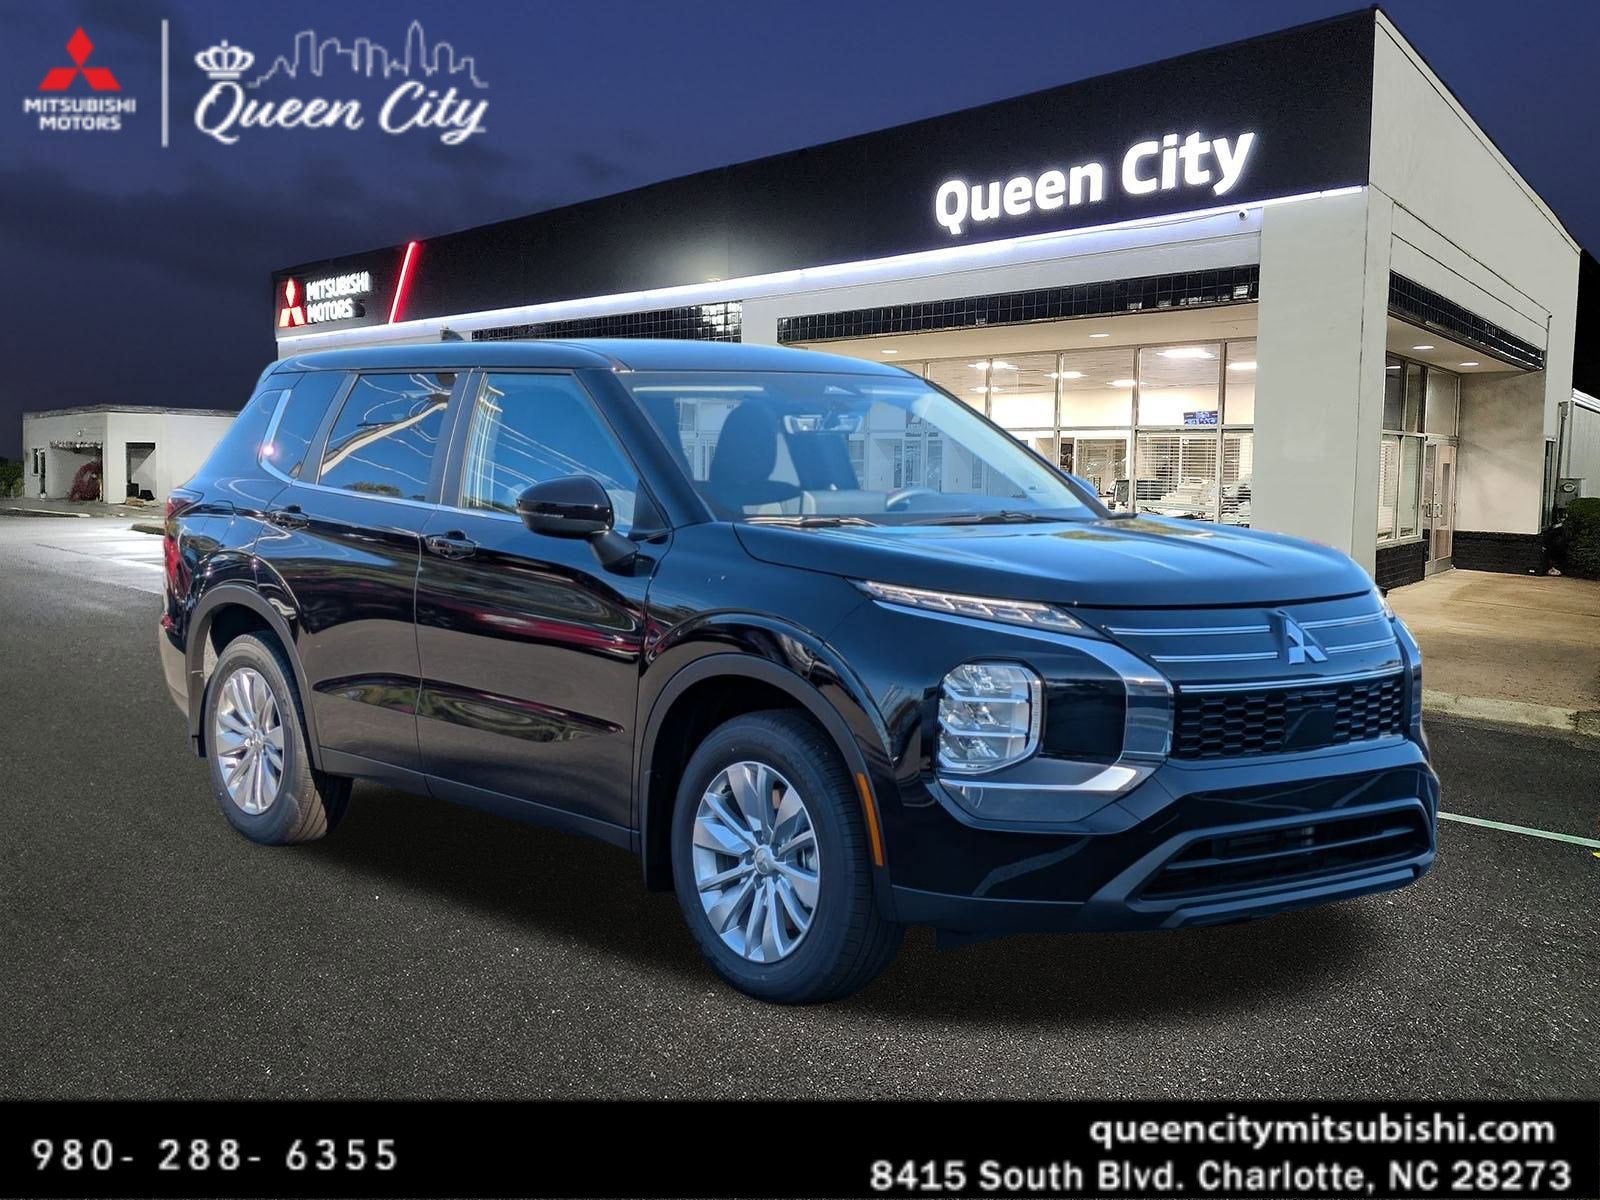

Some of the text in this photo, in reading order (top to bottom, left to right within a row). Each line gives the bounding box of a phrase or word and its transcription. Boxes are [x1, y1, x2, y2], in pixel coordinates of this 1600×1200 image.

[935, 131, 1255, 235] Queen City
[305, 270, 371, 301] MITSUBISHI
[306, 299, 354, 324] MOTORS
